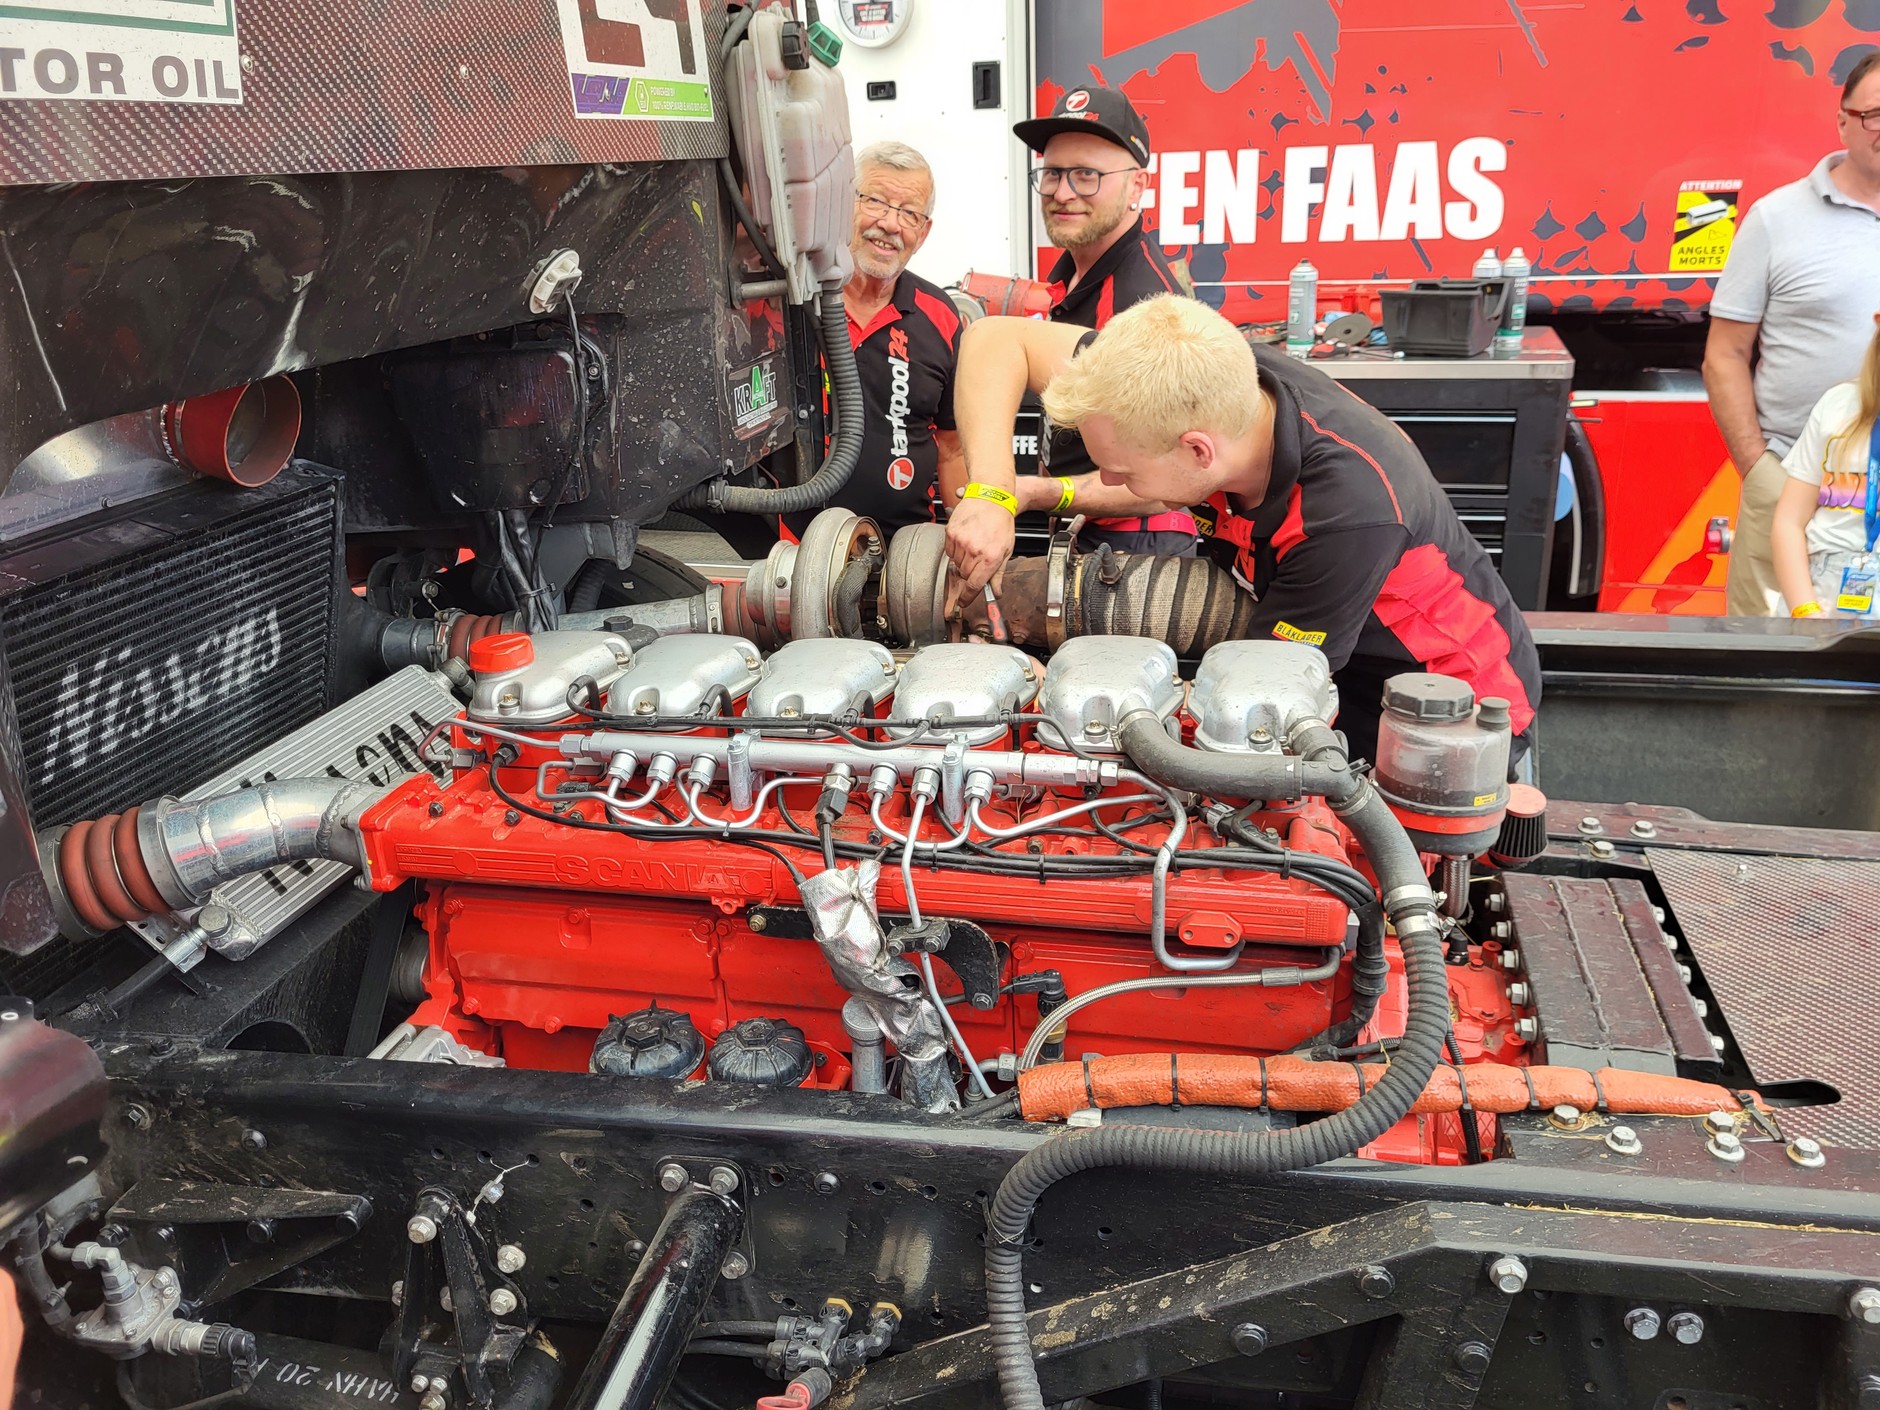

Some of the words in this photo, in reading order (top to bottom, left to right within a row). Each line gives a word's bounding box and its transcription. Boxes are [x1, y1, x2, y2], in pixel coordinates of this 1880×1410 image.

[0, 47, 127, 95] TOR
[152, 55, 240, 99] OIL
[1281, 136, 1508, 243] FAAS
[1679, 179, 1743, 191] ATTENTION
[1678, 245, 1725, 255] ANGLES
[1679, 256, 1722, 265] MORTS
[734, 365, 777, 418] KRAFT
[556, 854, 732, 893] SCANIA
